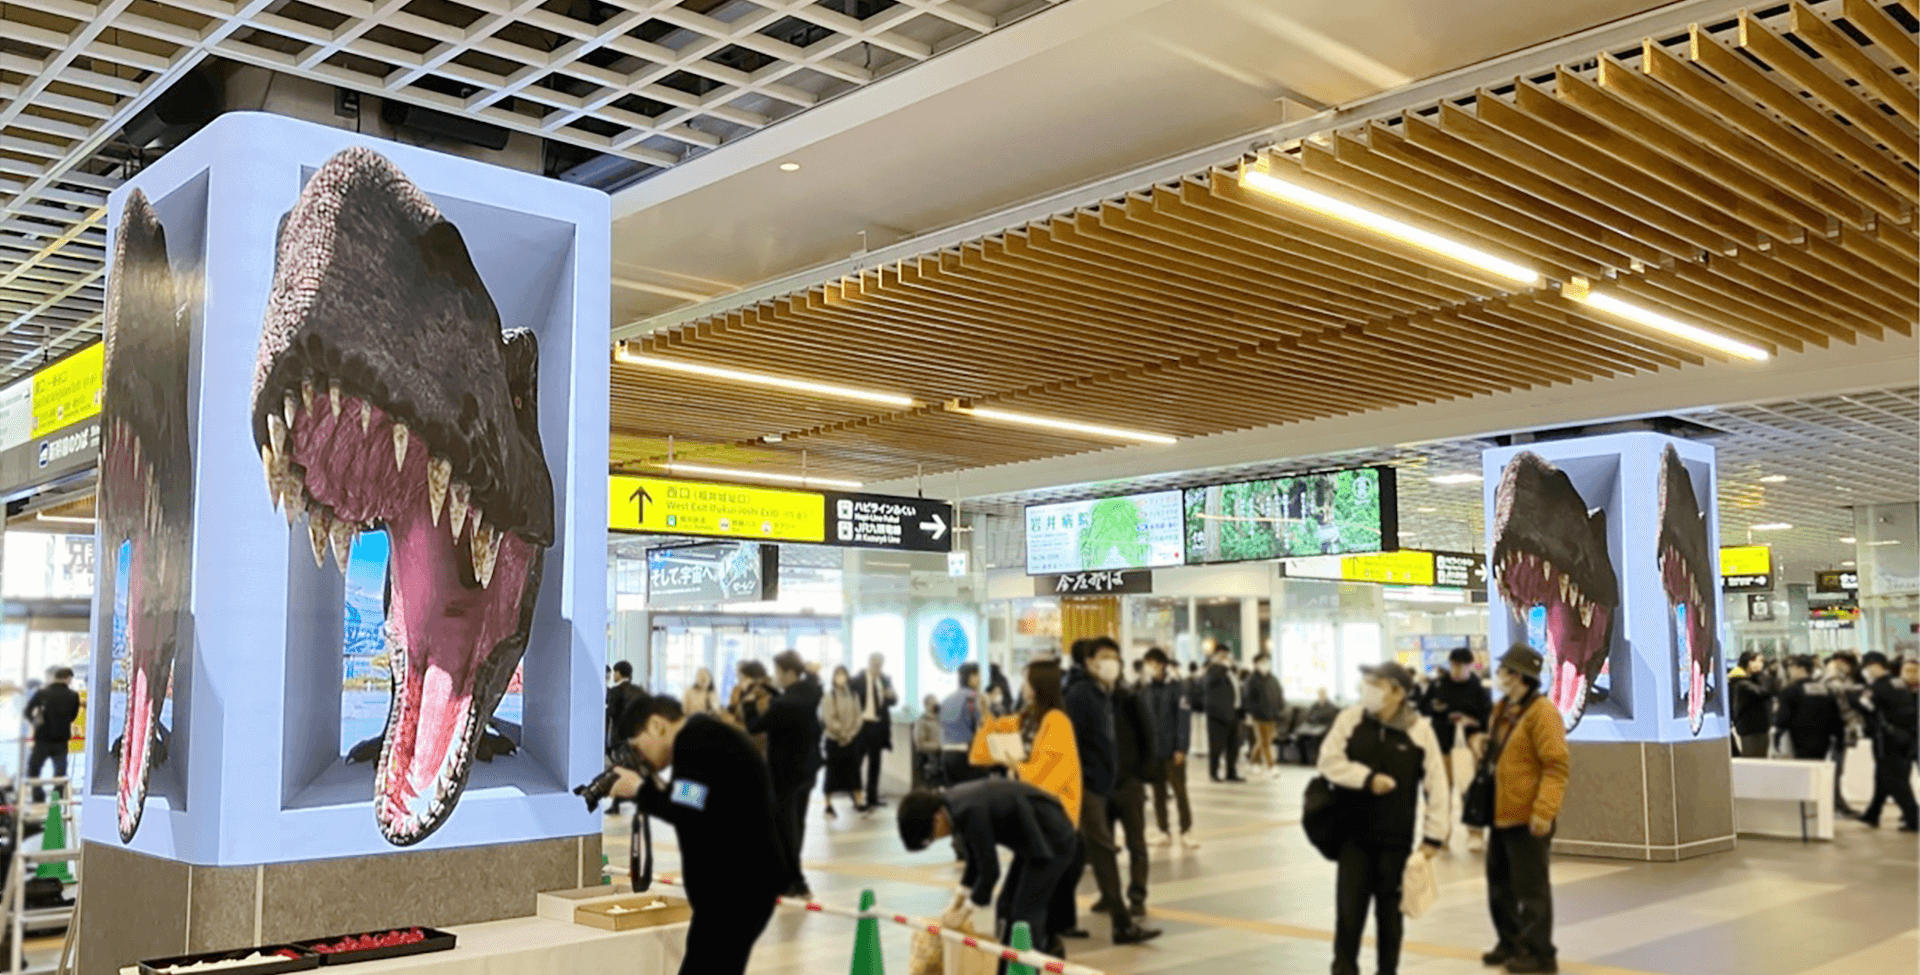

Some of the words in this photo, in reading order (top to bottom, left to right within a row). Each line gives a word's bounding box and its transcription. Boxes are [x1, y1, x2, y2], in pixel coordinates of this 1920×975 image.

[665, 500, 689, 511] West
[855, 502, 916, 516] ハピラインふくい
